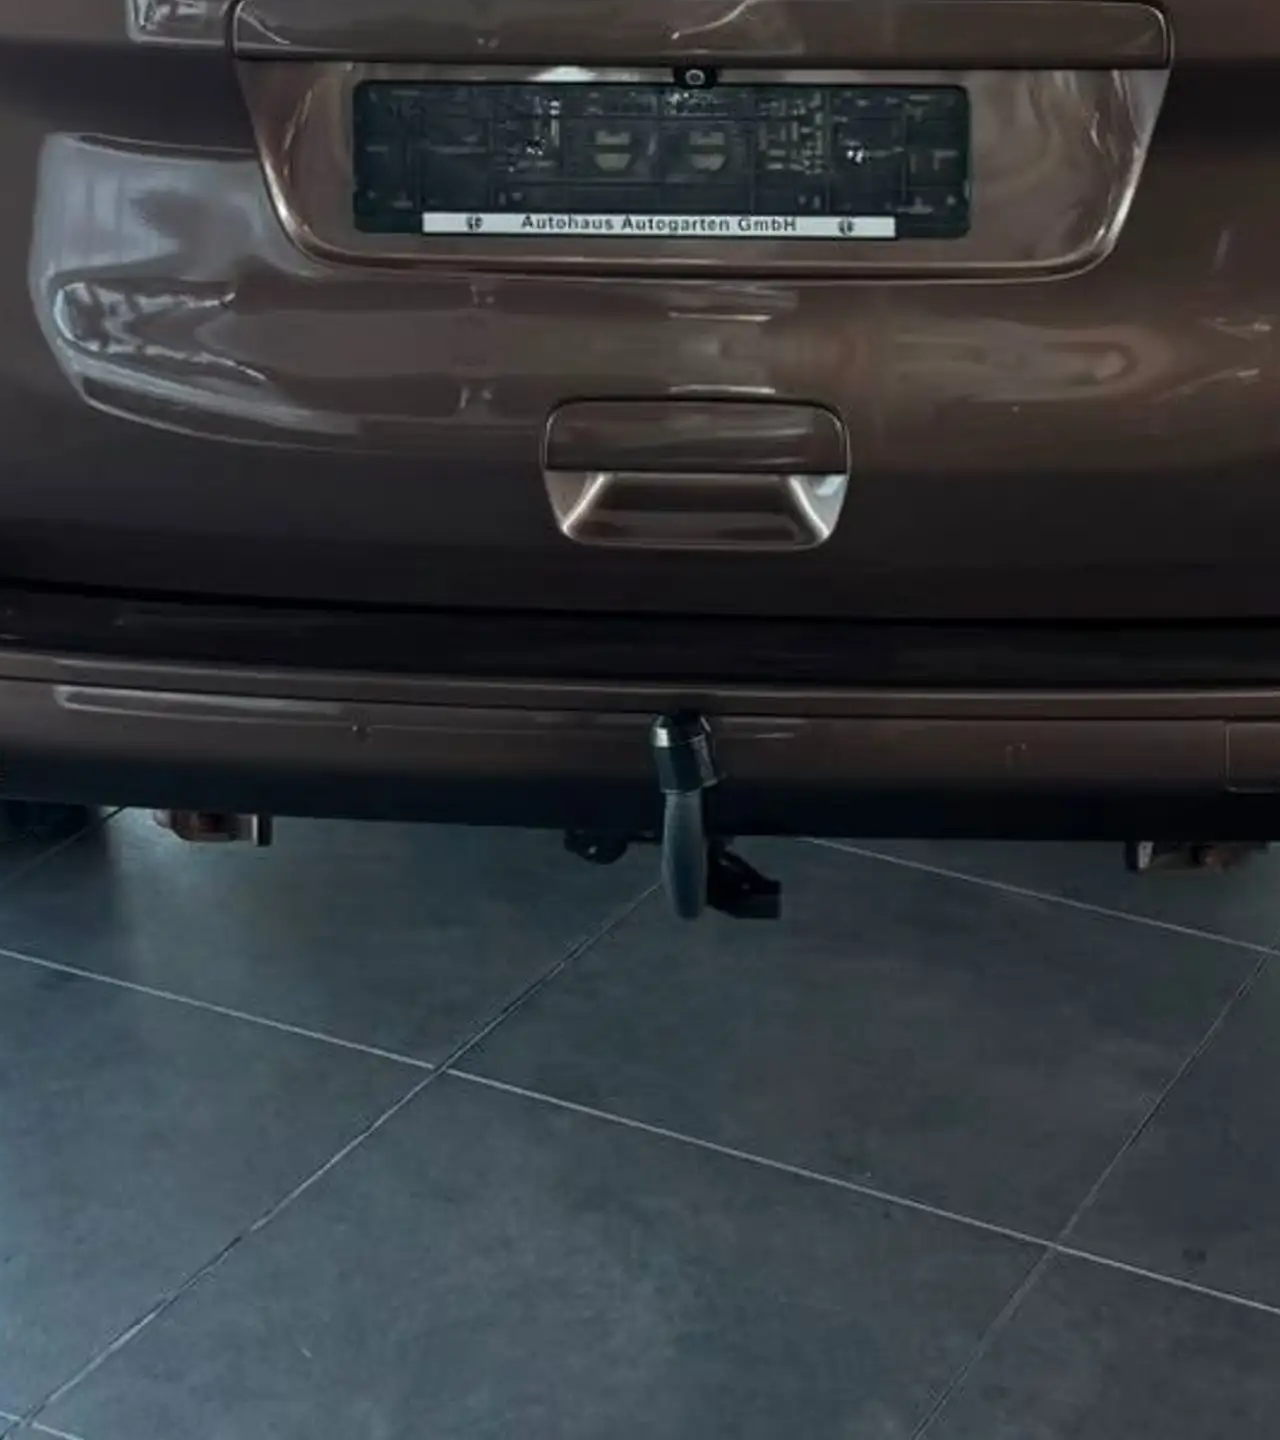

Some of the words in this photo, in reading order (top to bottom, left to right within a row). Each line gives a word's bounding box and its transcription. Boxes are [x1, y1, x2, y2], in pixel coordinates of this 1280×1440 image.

[522, 214, 614, 231] Autohaus
[621, 214, 730, 234] Autogarten
[738, 216, 797, 232] GmbH
